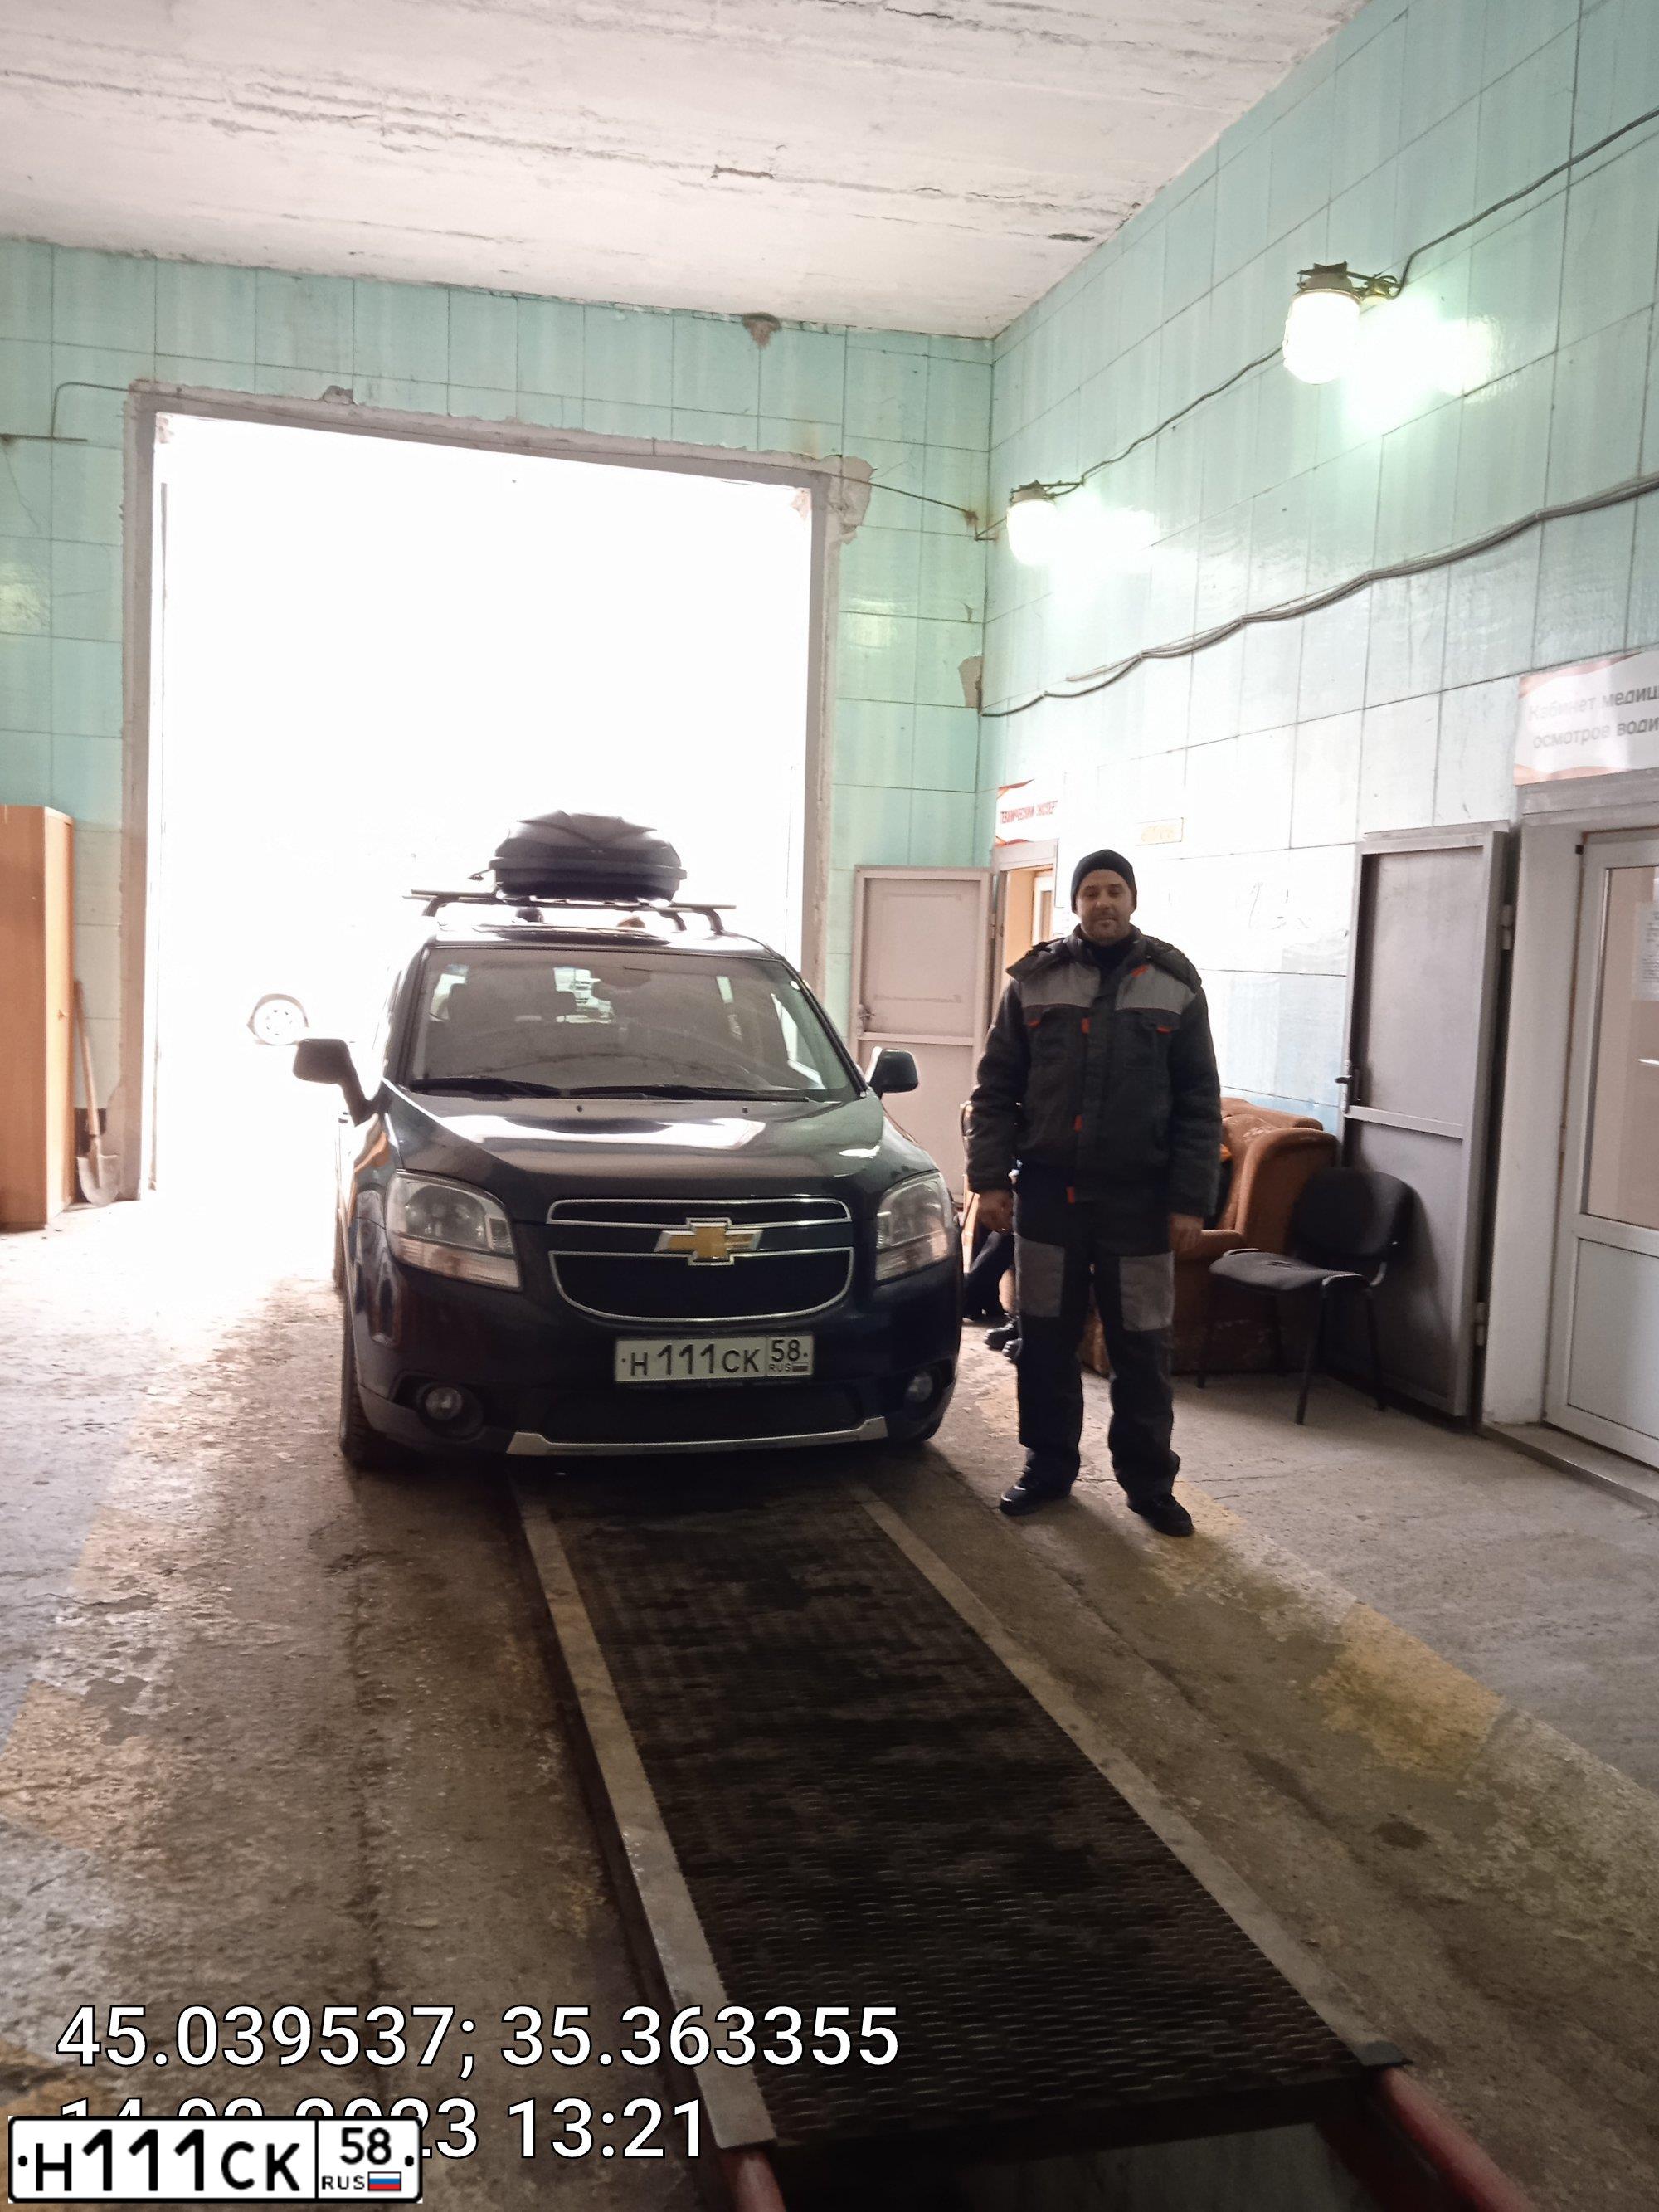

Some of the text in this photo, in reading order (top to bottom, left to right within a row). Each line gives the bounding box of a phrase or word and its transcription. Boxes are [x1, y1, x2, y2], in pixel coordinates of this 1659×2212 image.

[1602, 685, 1659, 708] медиц
[1533, 725, 1611, 749] осмотров
[630, 1339, 800, 1376] Н111СК 58
[768, 1363, 791, 1372] RUS
